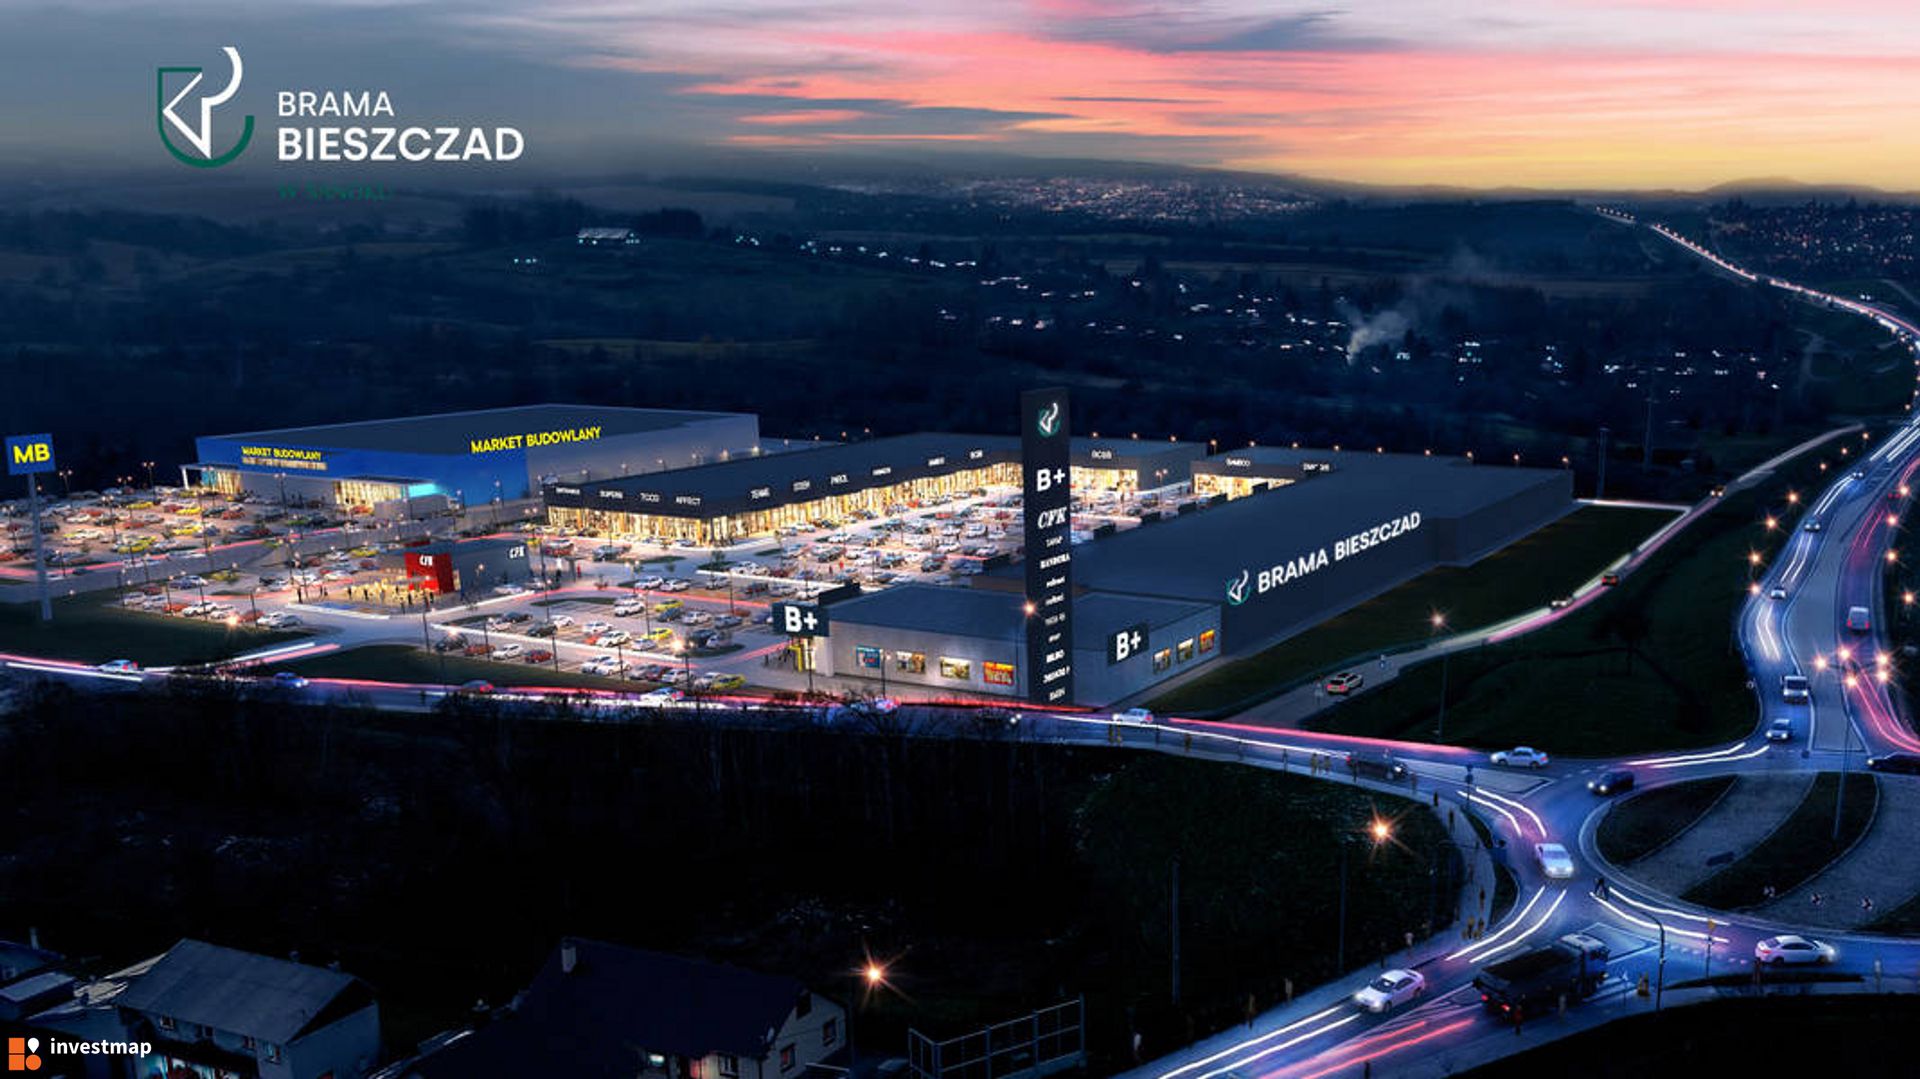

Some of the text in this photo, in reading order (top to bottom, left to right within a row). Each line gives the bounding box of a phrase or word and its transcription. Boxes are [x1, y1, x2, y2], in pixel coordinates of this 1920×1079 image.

[471, 426, 602, 454] MARKET BUDOWLANY
[13, 443, 51, 464] MB
[241, 446, 321, 461] MARKET BUDOWLANY
[1036, 467, 1066, 492] B+
[1037, 506, 1068, 530] CFK
[1258, 511, 1421, 595] BRAMA BIESZCZAD
[785, 605, 818, 633] B+
[1116, 631, 1141, 661] B+
